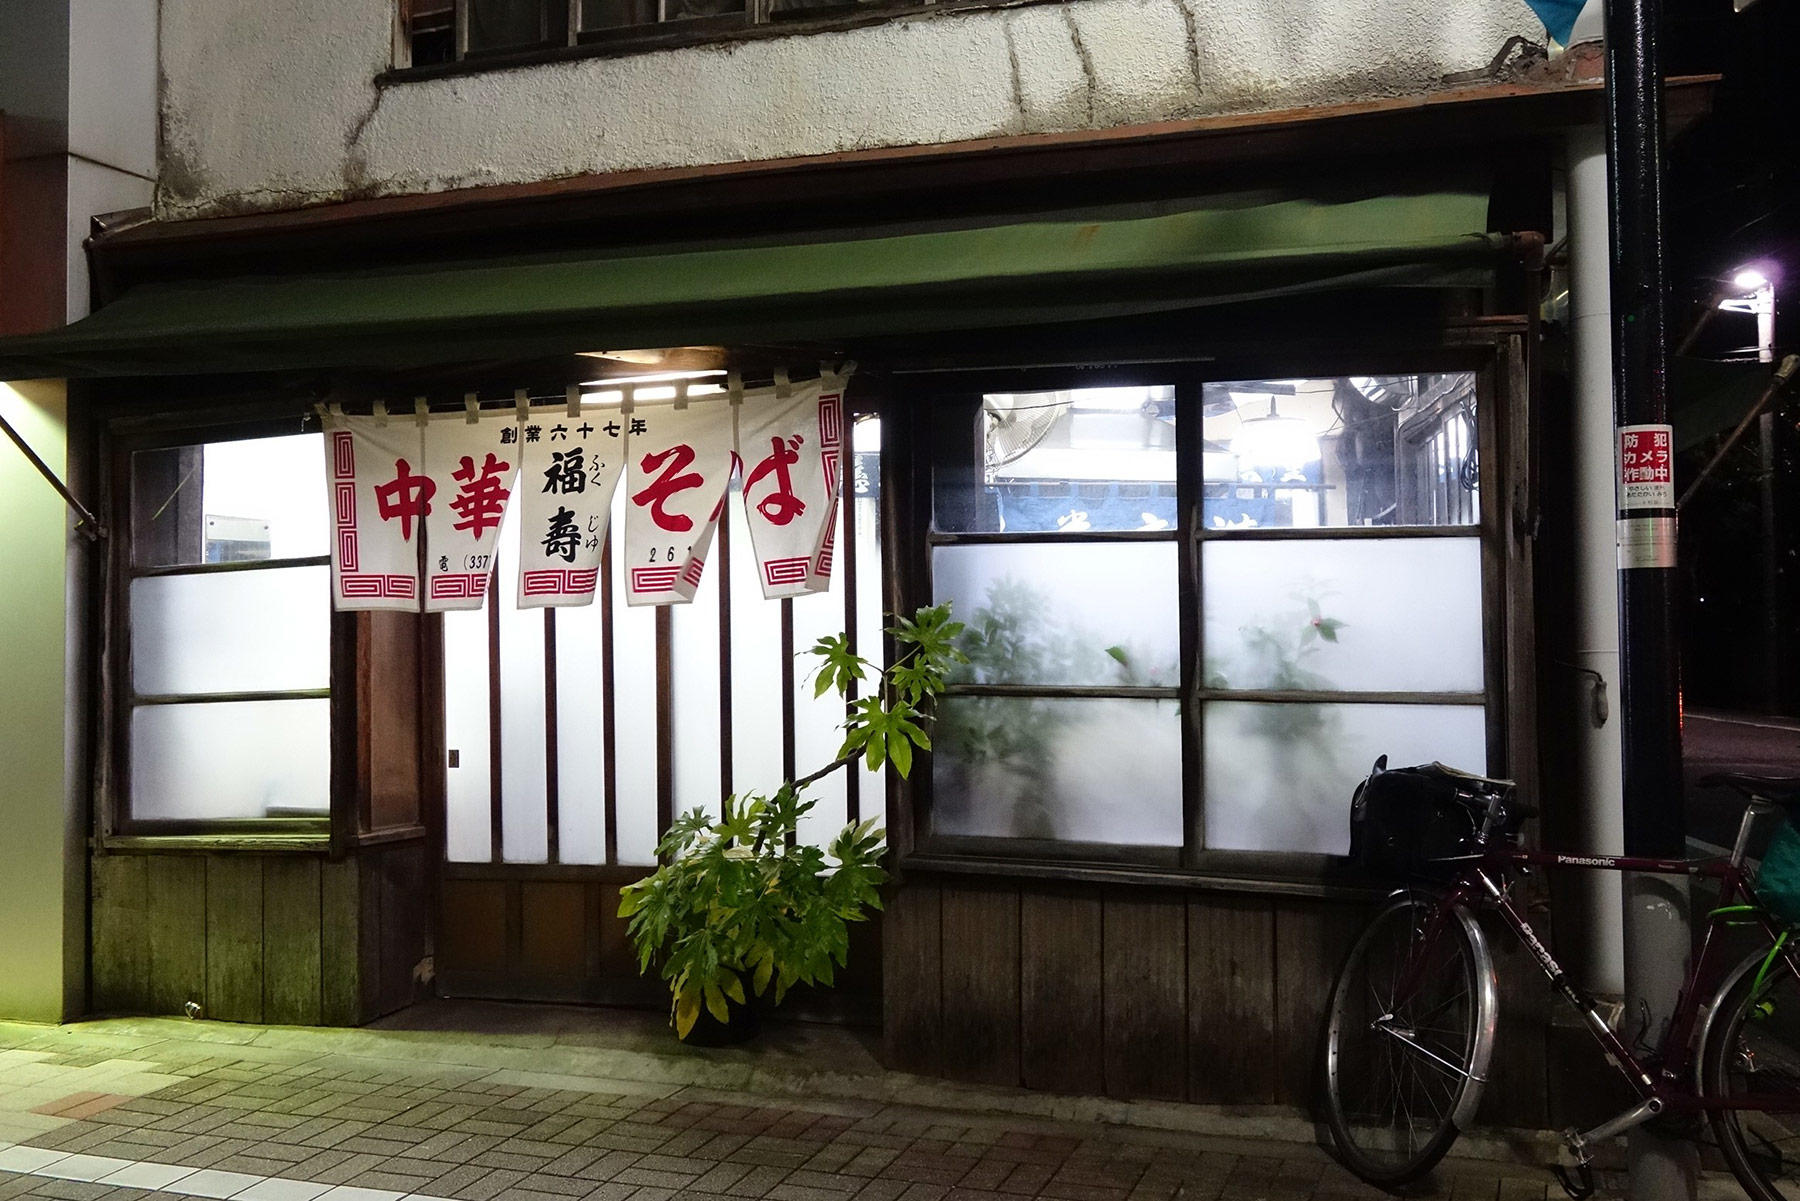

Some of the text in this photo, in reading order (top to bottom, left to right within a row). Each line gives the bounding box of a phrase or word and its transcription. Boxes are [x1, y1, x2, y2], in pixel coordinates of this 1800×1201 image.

[500, 418, 647, 444] 創業六十七年
[1624, 433, 1668, 448] 防犯
[1624, 450, 1668, 464] カメラ
[1625, 465, 1668, 481] 作動中
[374, 452, 511, 543] 中華
[632, 434, 806, 532] そば
[463, 554, 492, 571] (337
[1557, 855, 1616, 868] Panasonic
